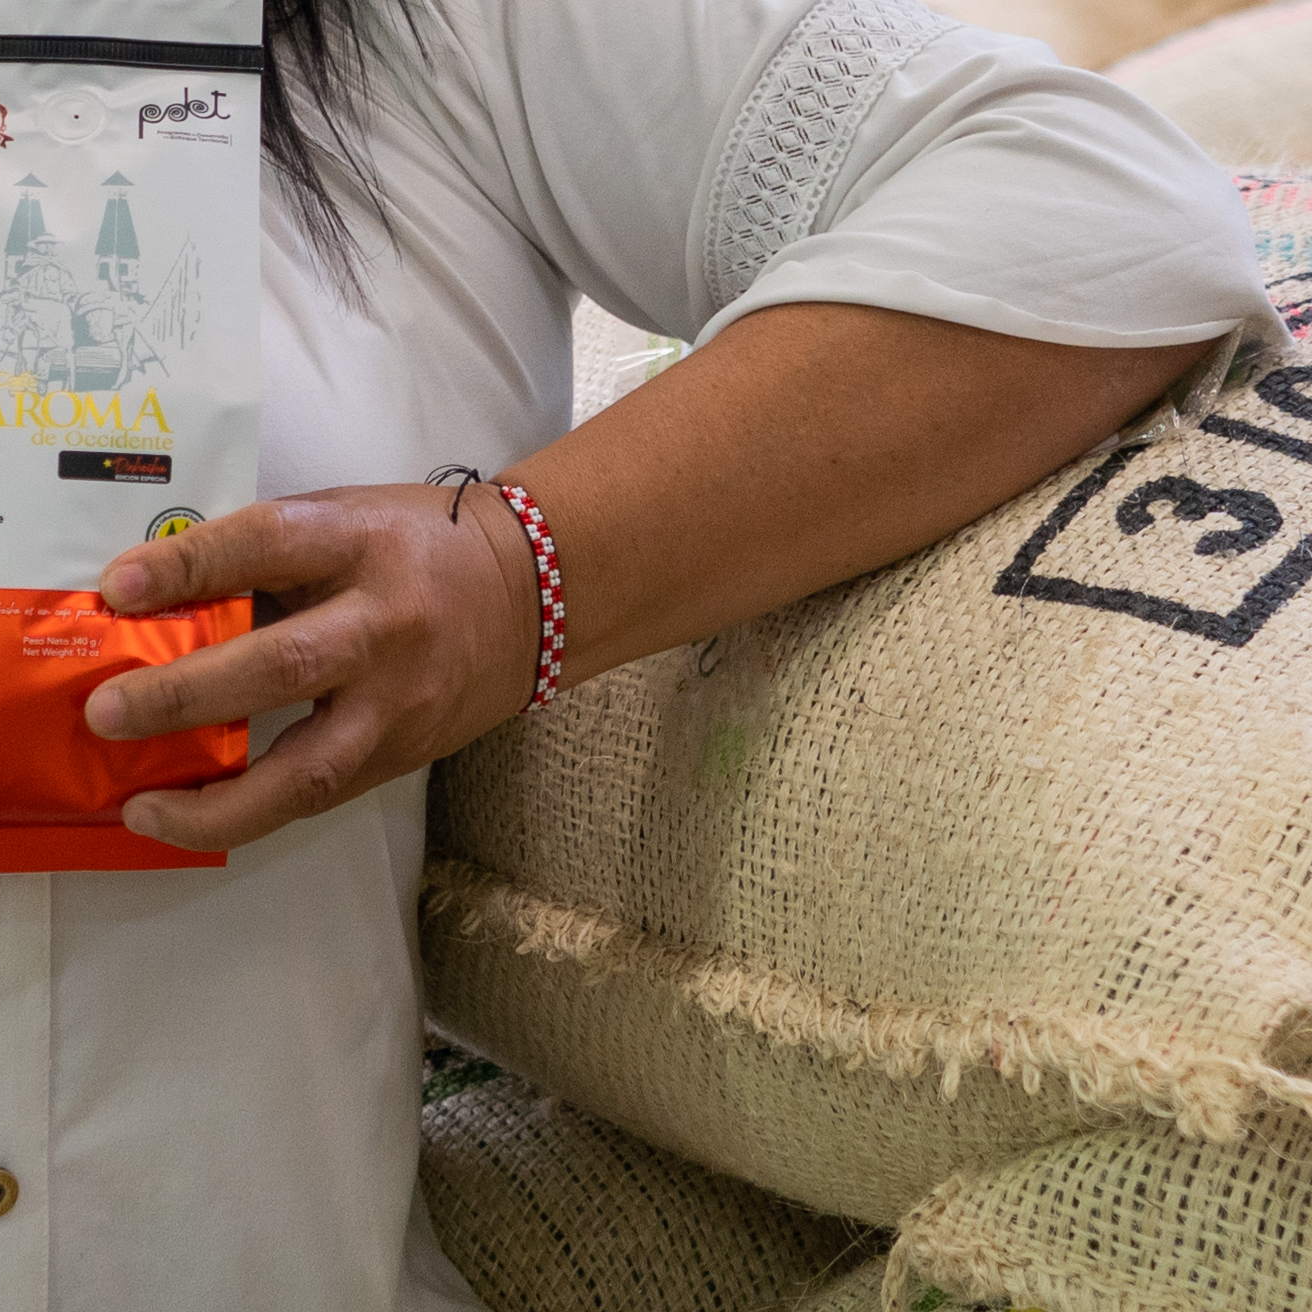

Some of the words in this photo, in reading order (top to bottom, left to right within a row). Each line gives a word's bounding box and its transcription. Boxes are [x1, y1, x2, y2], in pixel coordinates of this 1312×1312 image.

[138, 87, 231, 140] pdet
[31, 427, 58, 447] de
[65, 428, 175, 451] Occidente
[1115, 475, 1284, 556] 3
[22, 636, 44, 646] Peso
[46, 637, 69, 646] Neto
[71, 637, 88, 646] 340
[22, 647, 40, 657] Net
[41, 648, 74, 659] Weight
[76, 648, 86, 657] 12
